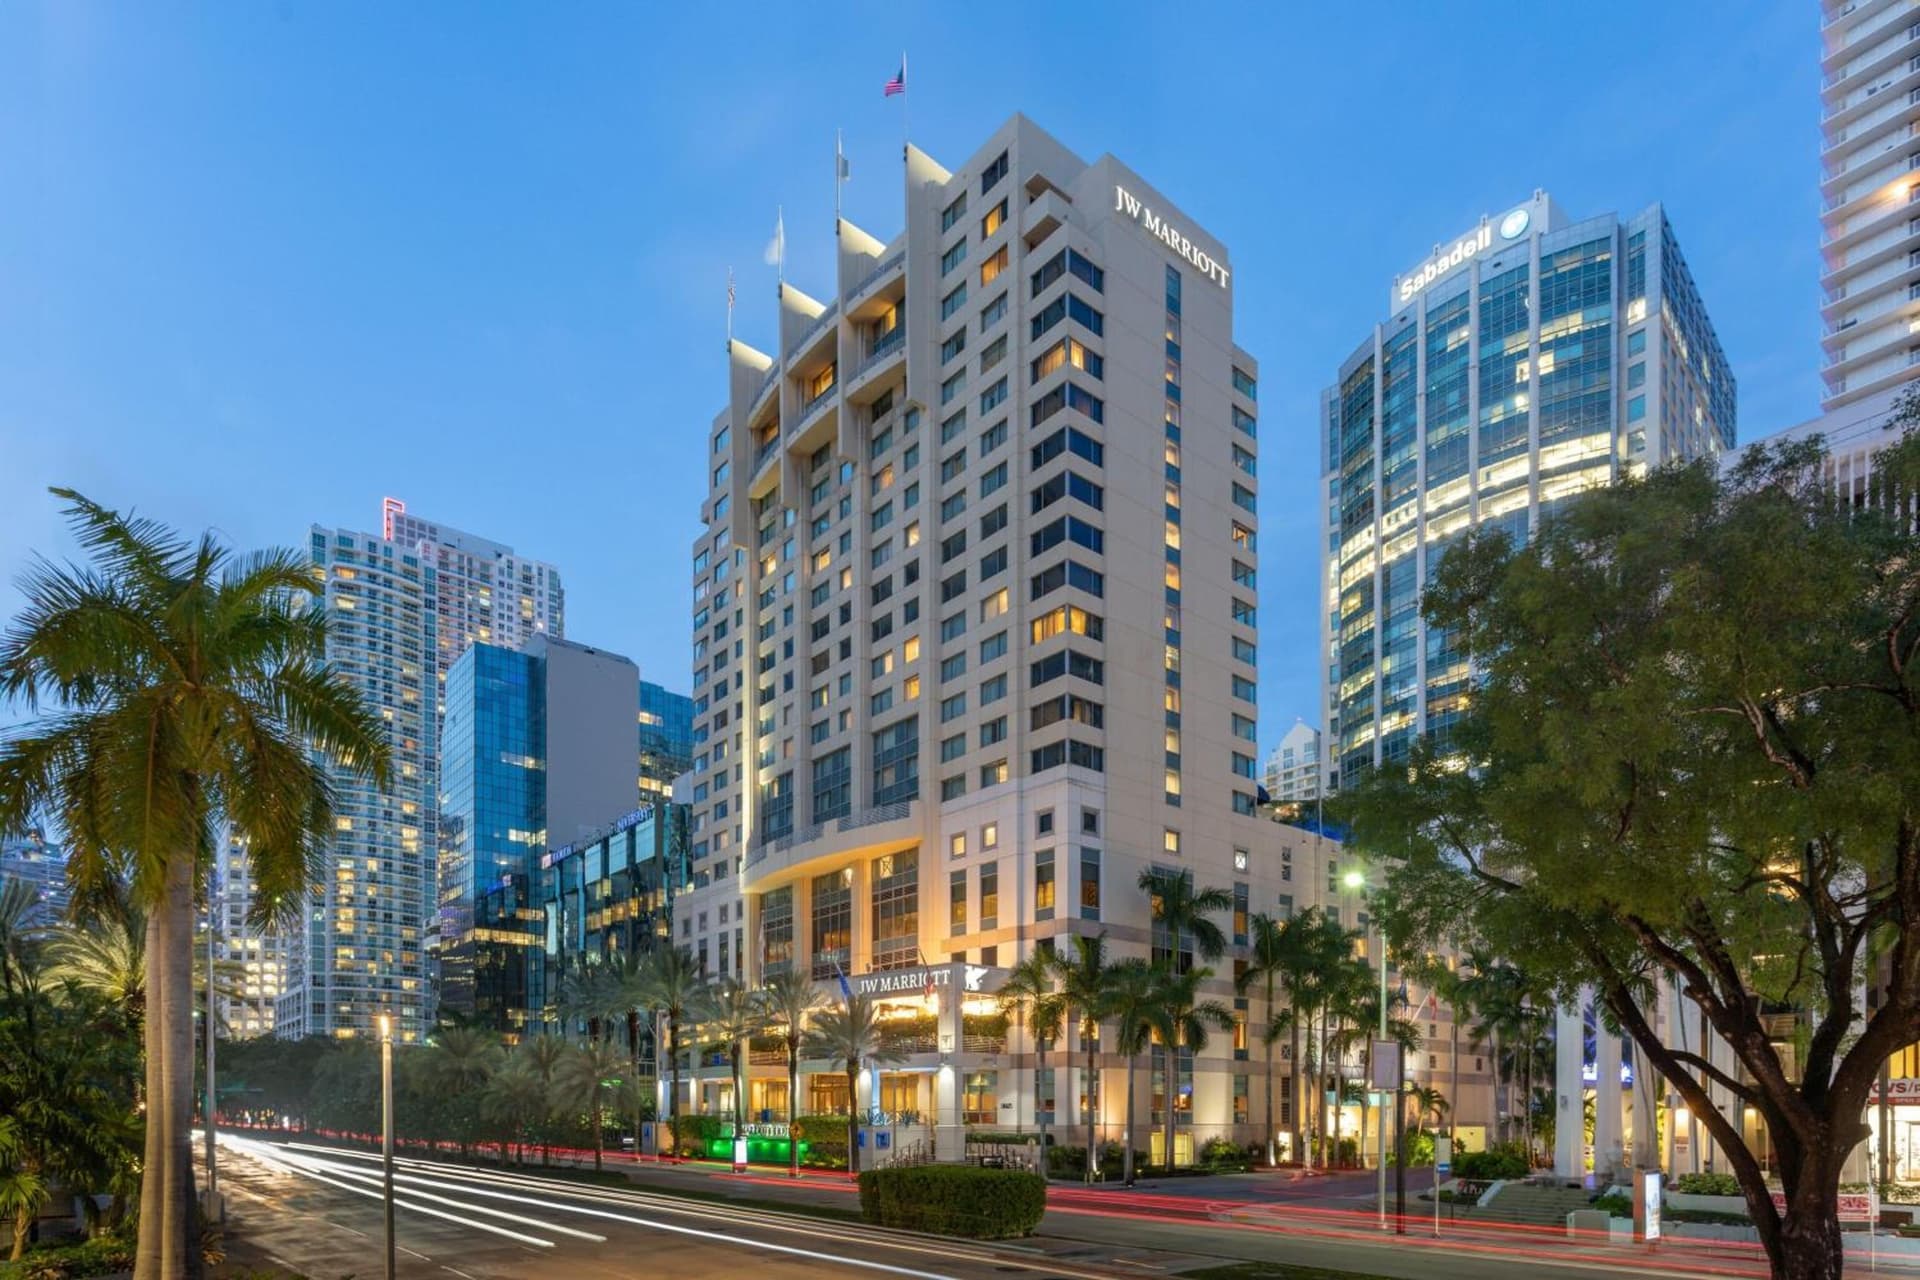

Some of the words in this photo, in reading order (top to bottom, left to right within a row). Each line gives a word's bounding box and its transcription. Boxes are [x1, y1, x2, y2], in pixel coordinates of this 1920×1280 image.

[1115, 185, 1142, 219] JW
[1144, 207, 1230, 289] MARRIOTT
[1400, 226, 1492, 301] Sabadell
[859, 978, 879, 994] JW
